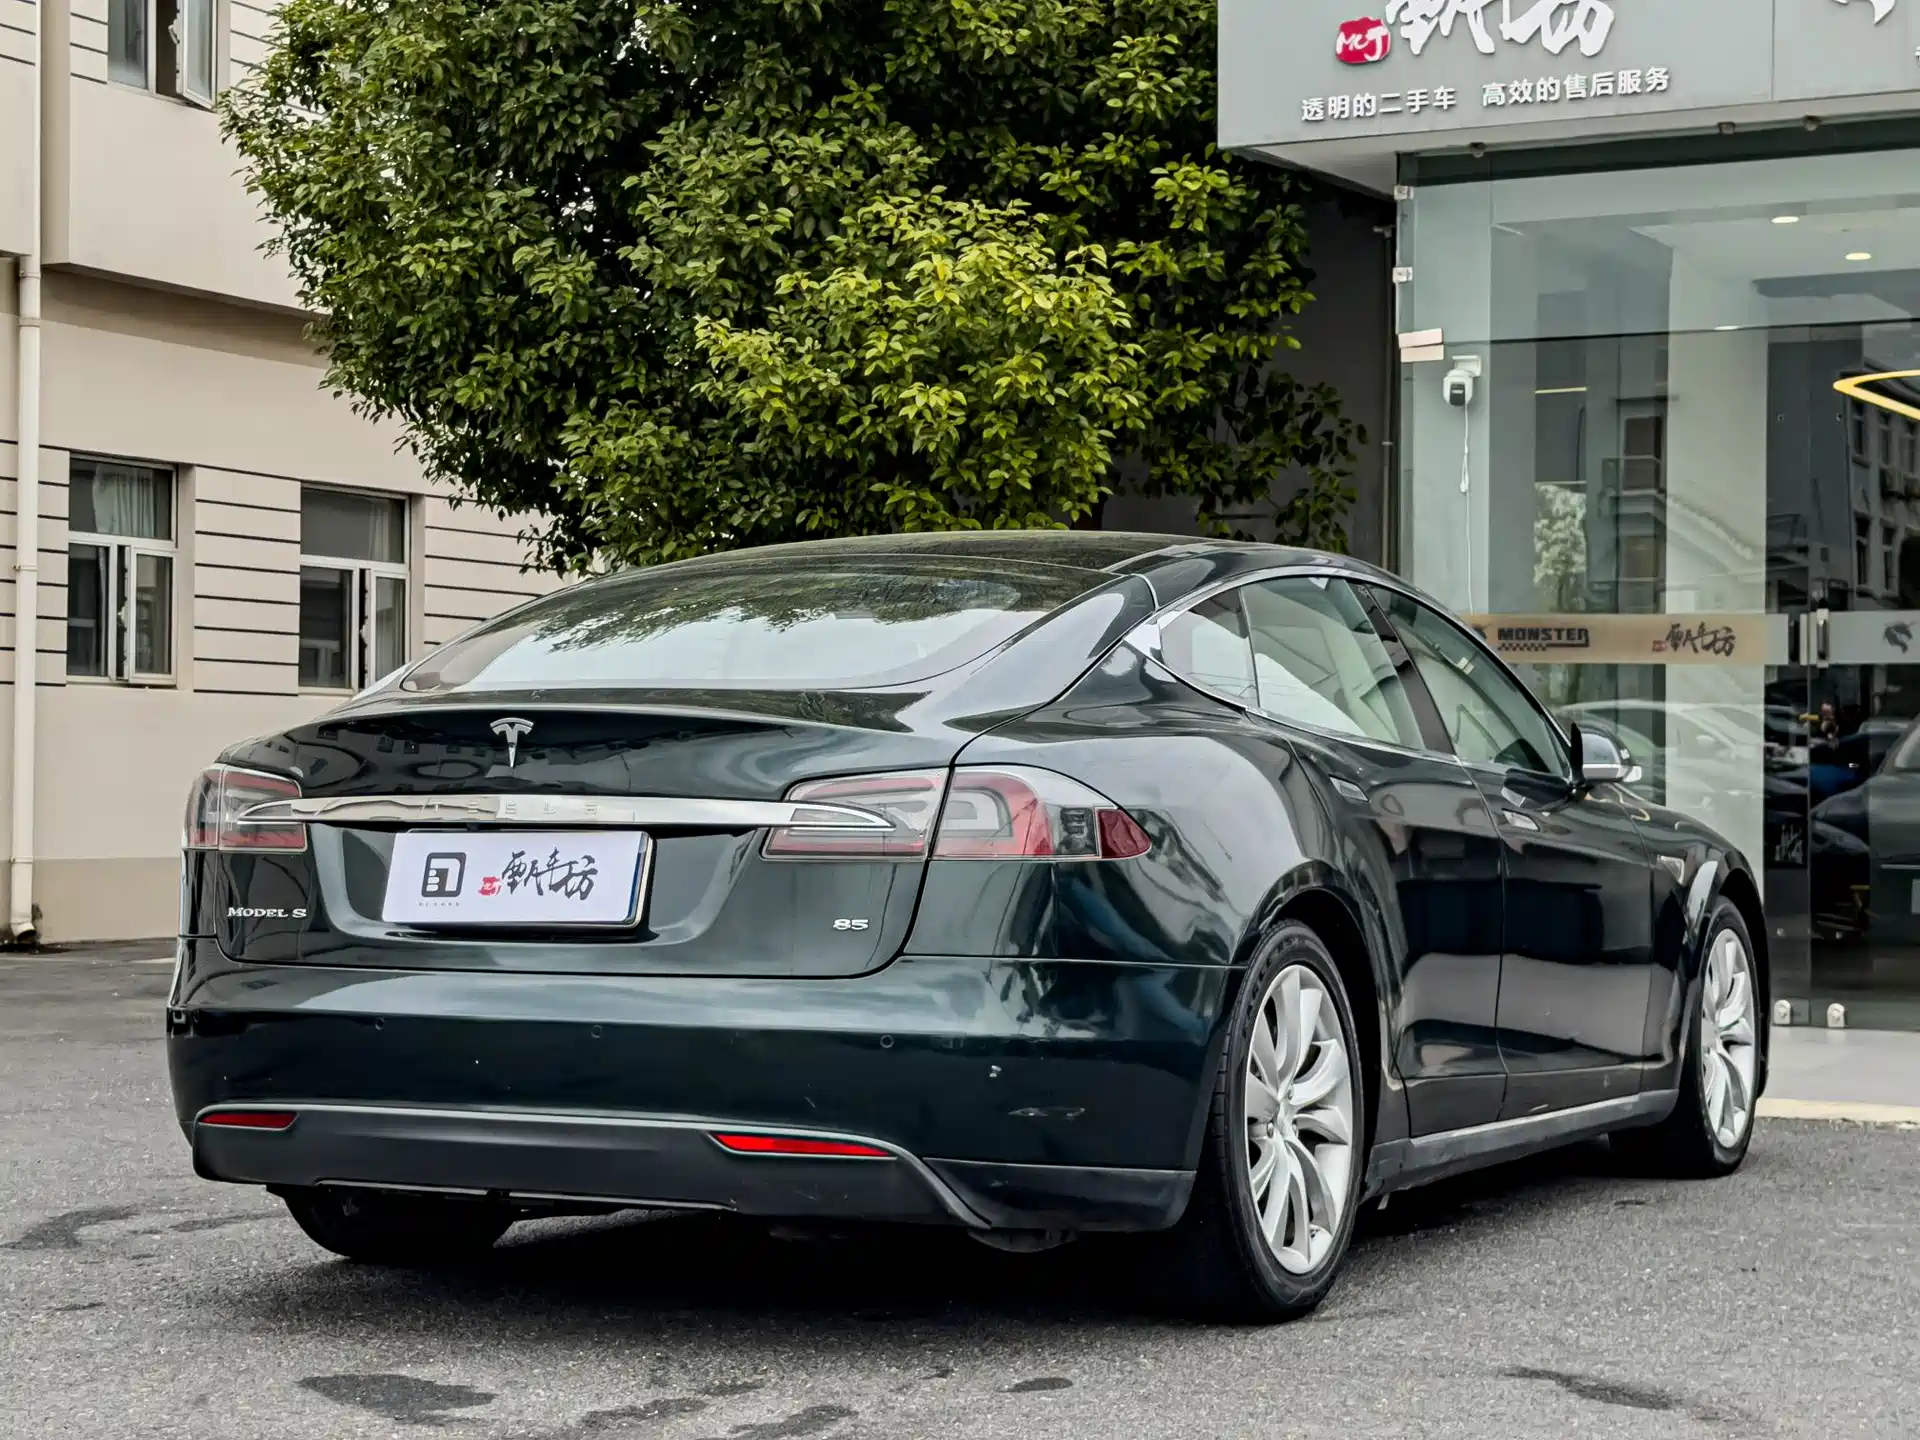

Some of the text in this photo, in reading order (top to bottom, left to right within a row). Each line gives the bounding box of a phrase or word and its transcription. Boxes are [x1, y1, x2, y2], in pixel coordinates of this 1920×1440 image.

[1300, 65, 1671, 122] 透明的二手车 高效的售后服务
[227, 907, 307, 918] MODEL S
[832, 918, 869, 930] 85
